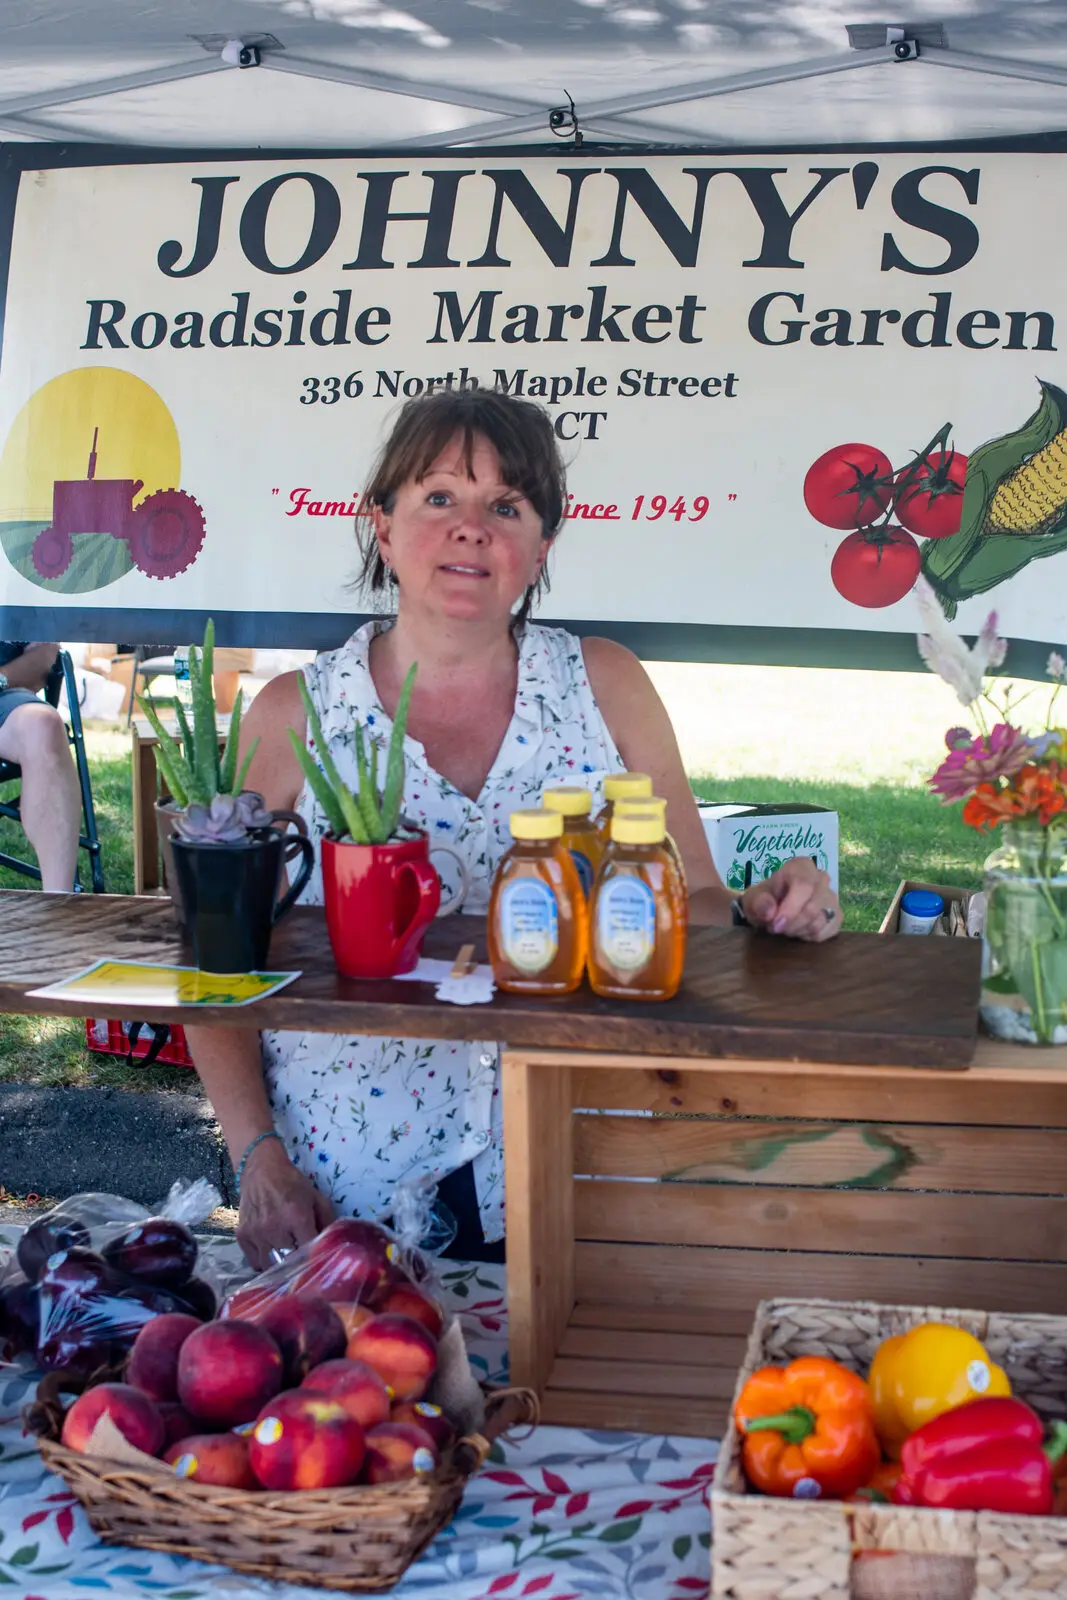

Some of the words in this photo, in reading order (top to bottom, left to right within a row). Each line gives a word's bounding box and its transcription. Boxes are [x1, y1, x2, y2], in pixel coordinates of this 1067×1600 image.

[157, 161, 981, 278] JOHNNY'S
[79, 290, 391, 350] Roadside
[426, 285, 707, 344] Market
[747, 291, 1058, 351] Garden
[299, 370, 364, 405] 336
[492, 367, 607, 404] Maple
[616, 370, 740, 398] Street
[554, 411, 607, 441] CT
[560, 493, 621, 520] ince
[631, 495, 710, 522] 1949
[733, 824, 824, 860] Vegetables
